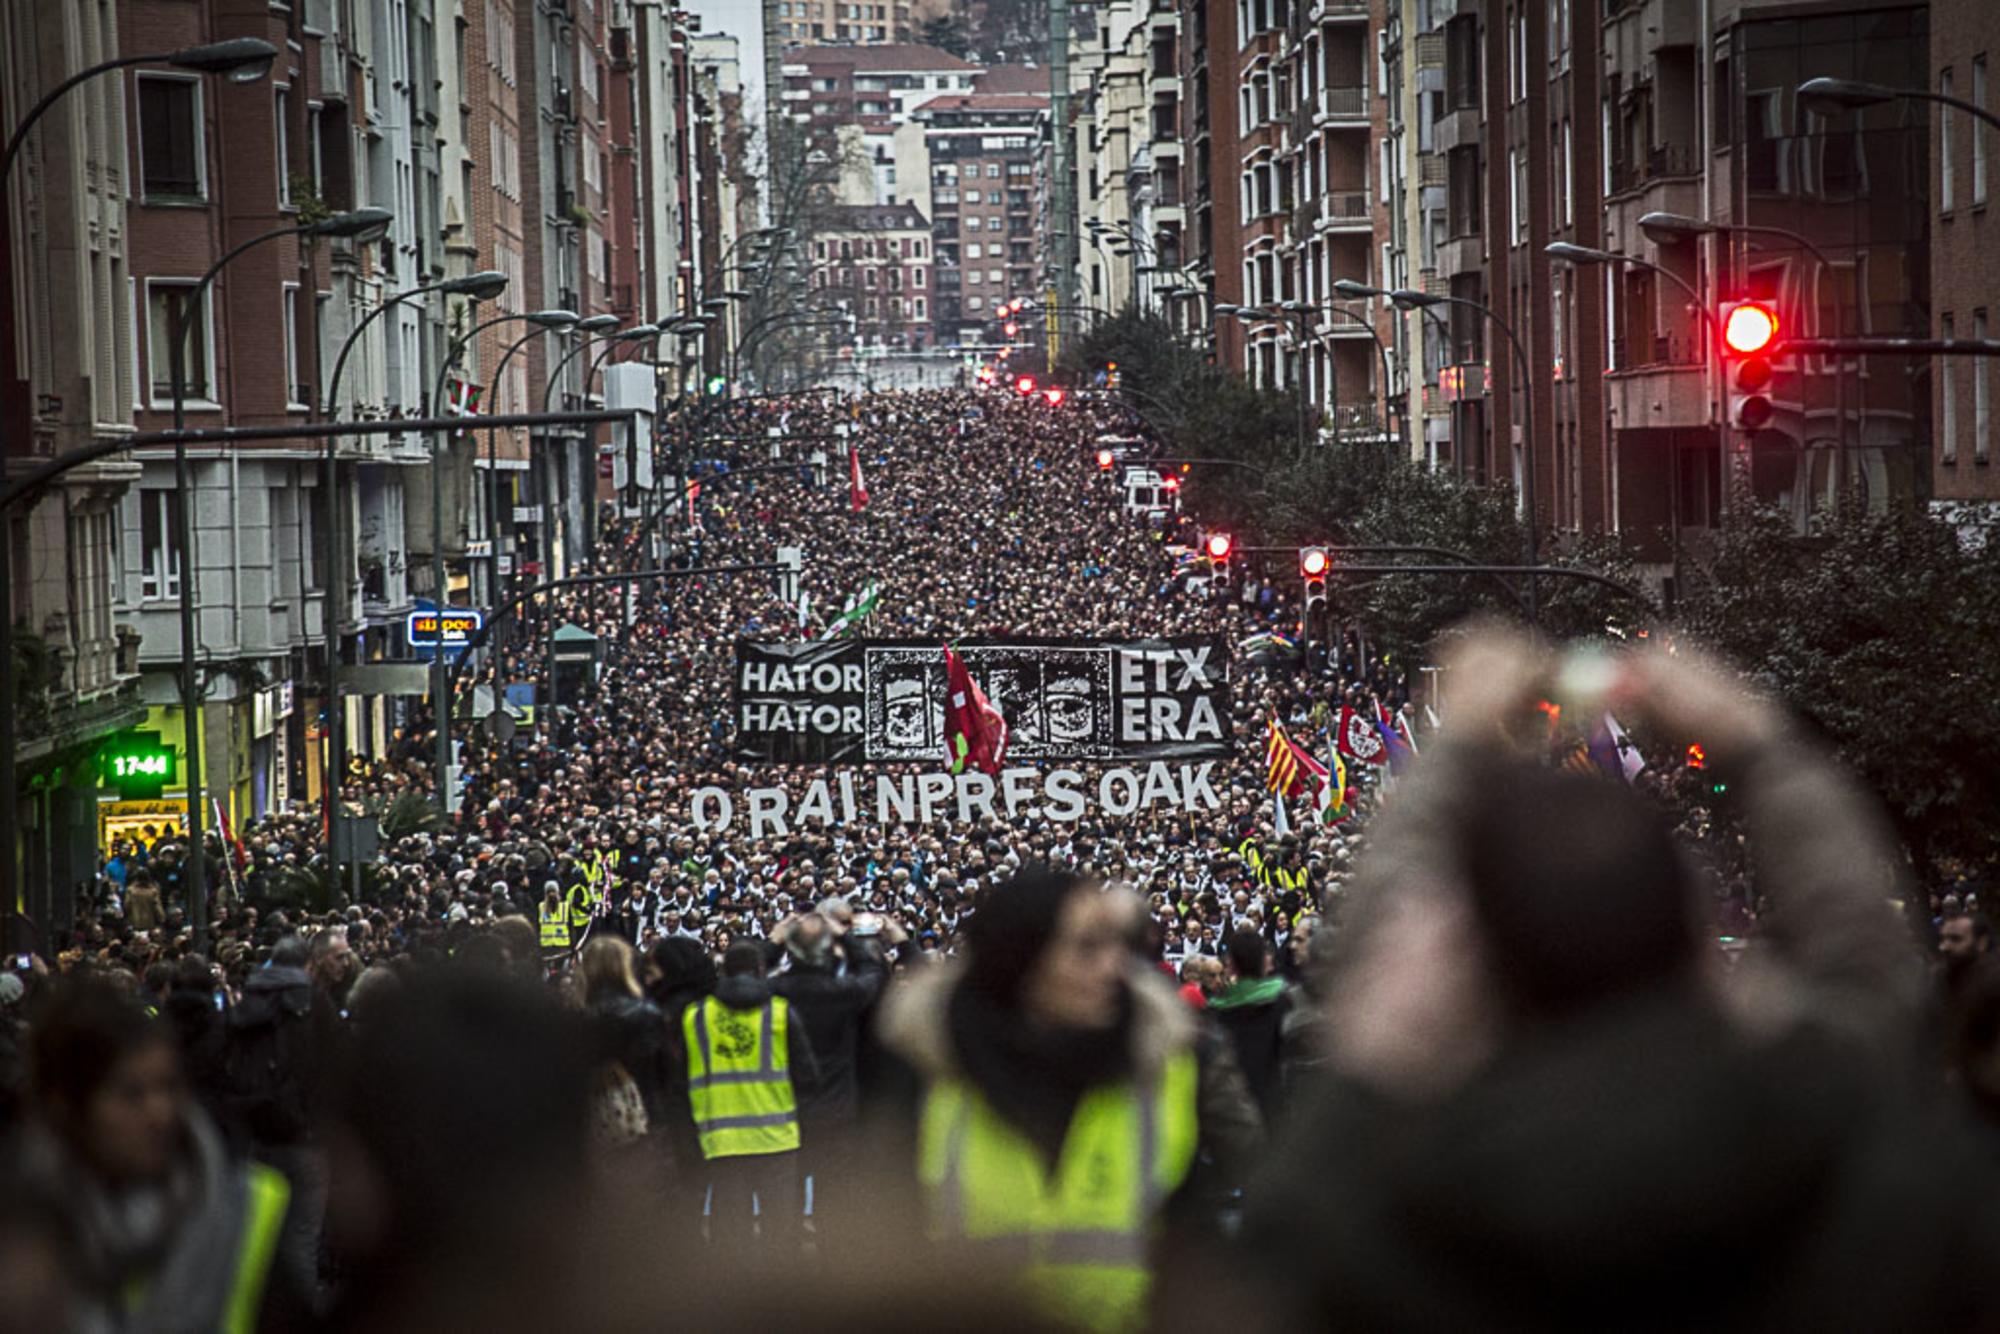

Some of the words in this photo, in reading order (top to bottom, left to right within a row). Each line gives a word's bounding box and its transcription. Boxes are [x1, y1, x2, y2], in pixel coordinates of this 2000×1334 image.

[741, 662, 864, 693] HATOR
[1120, 646, 1214, 692] ETX
[741, 704, 864, 733] HATOR
[1122, 696, 1223, 741] ERA
